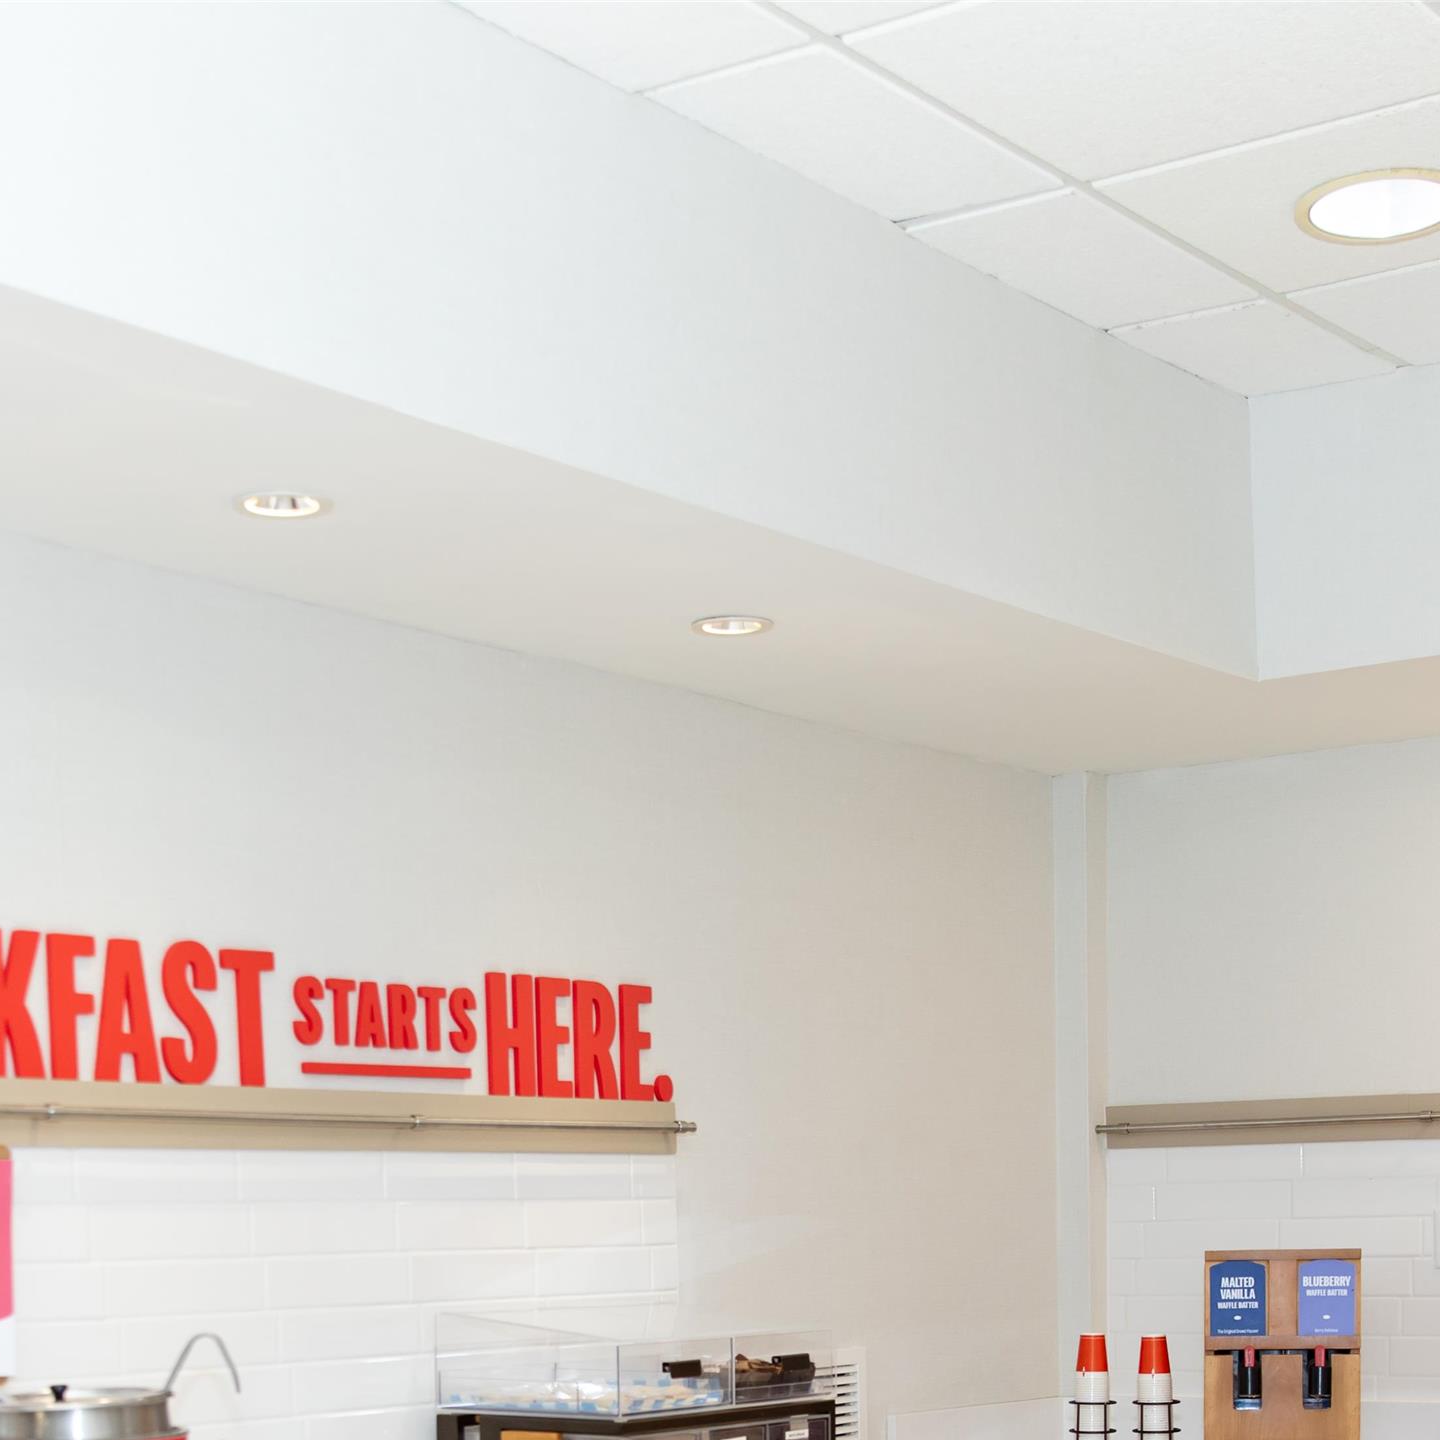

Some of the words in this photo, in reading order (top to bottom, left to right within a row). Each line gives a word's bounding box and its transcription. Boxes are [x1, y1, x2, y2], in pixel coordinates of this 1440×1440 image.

[292, 975, 478, 1053] STARTS
[485, 972, 674, 1102] HERE.
[1220, 1276, 1255, 1288] MALTED
[1302, 1275, 1352, 1287] BLUEBERRY
[1220, 1288, 1256, 1300] VANILLA
